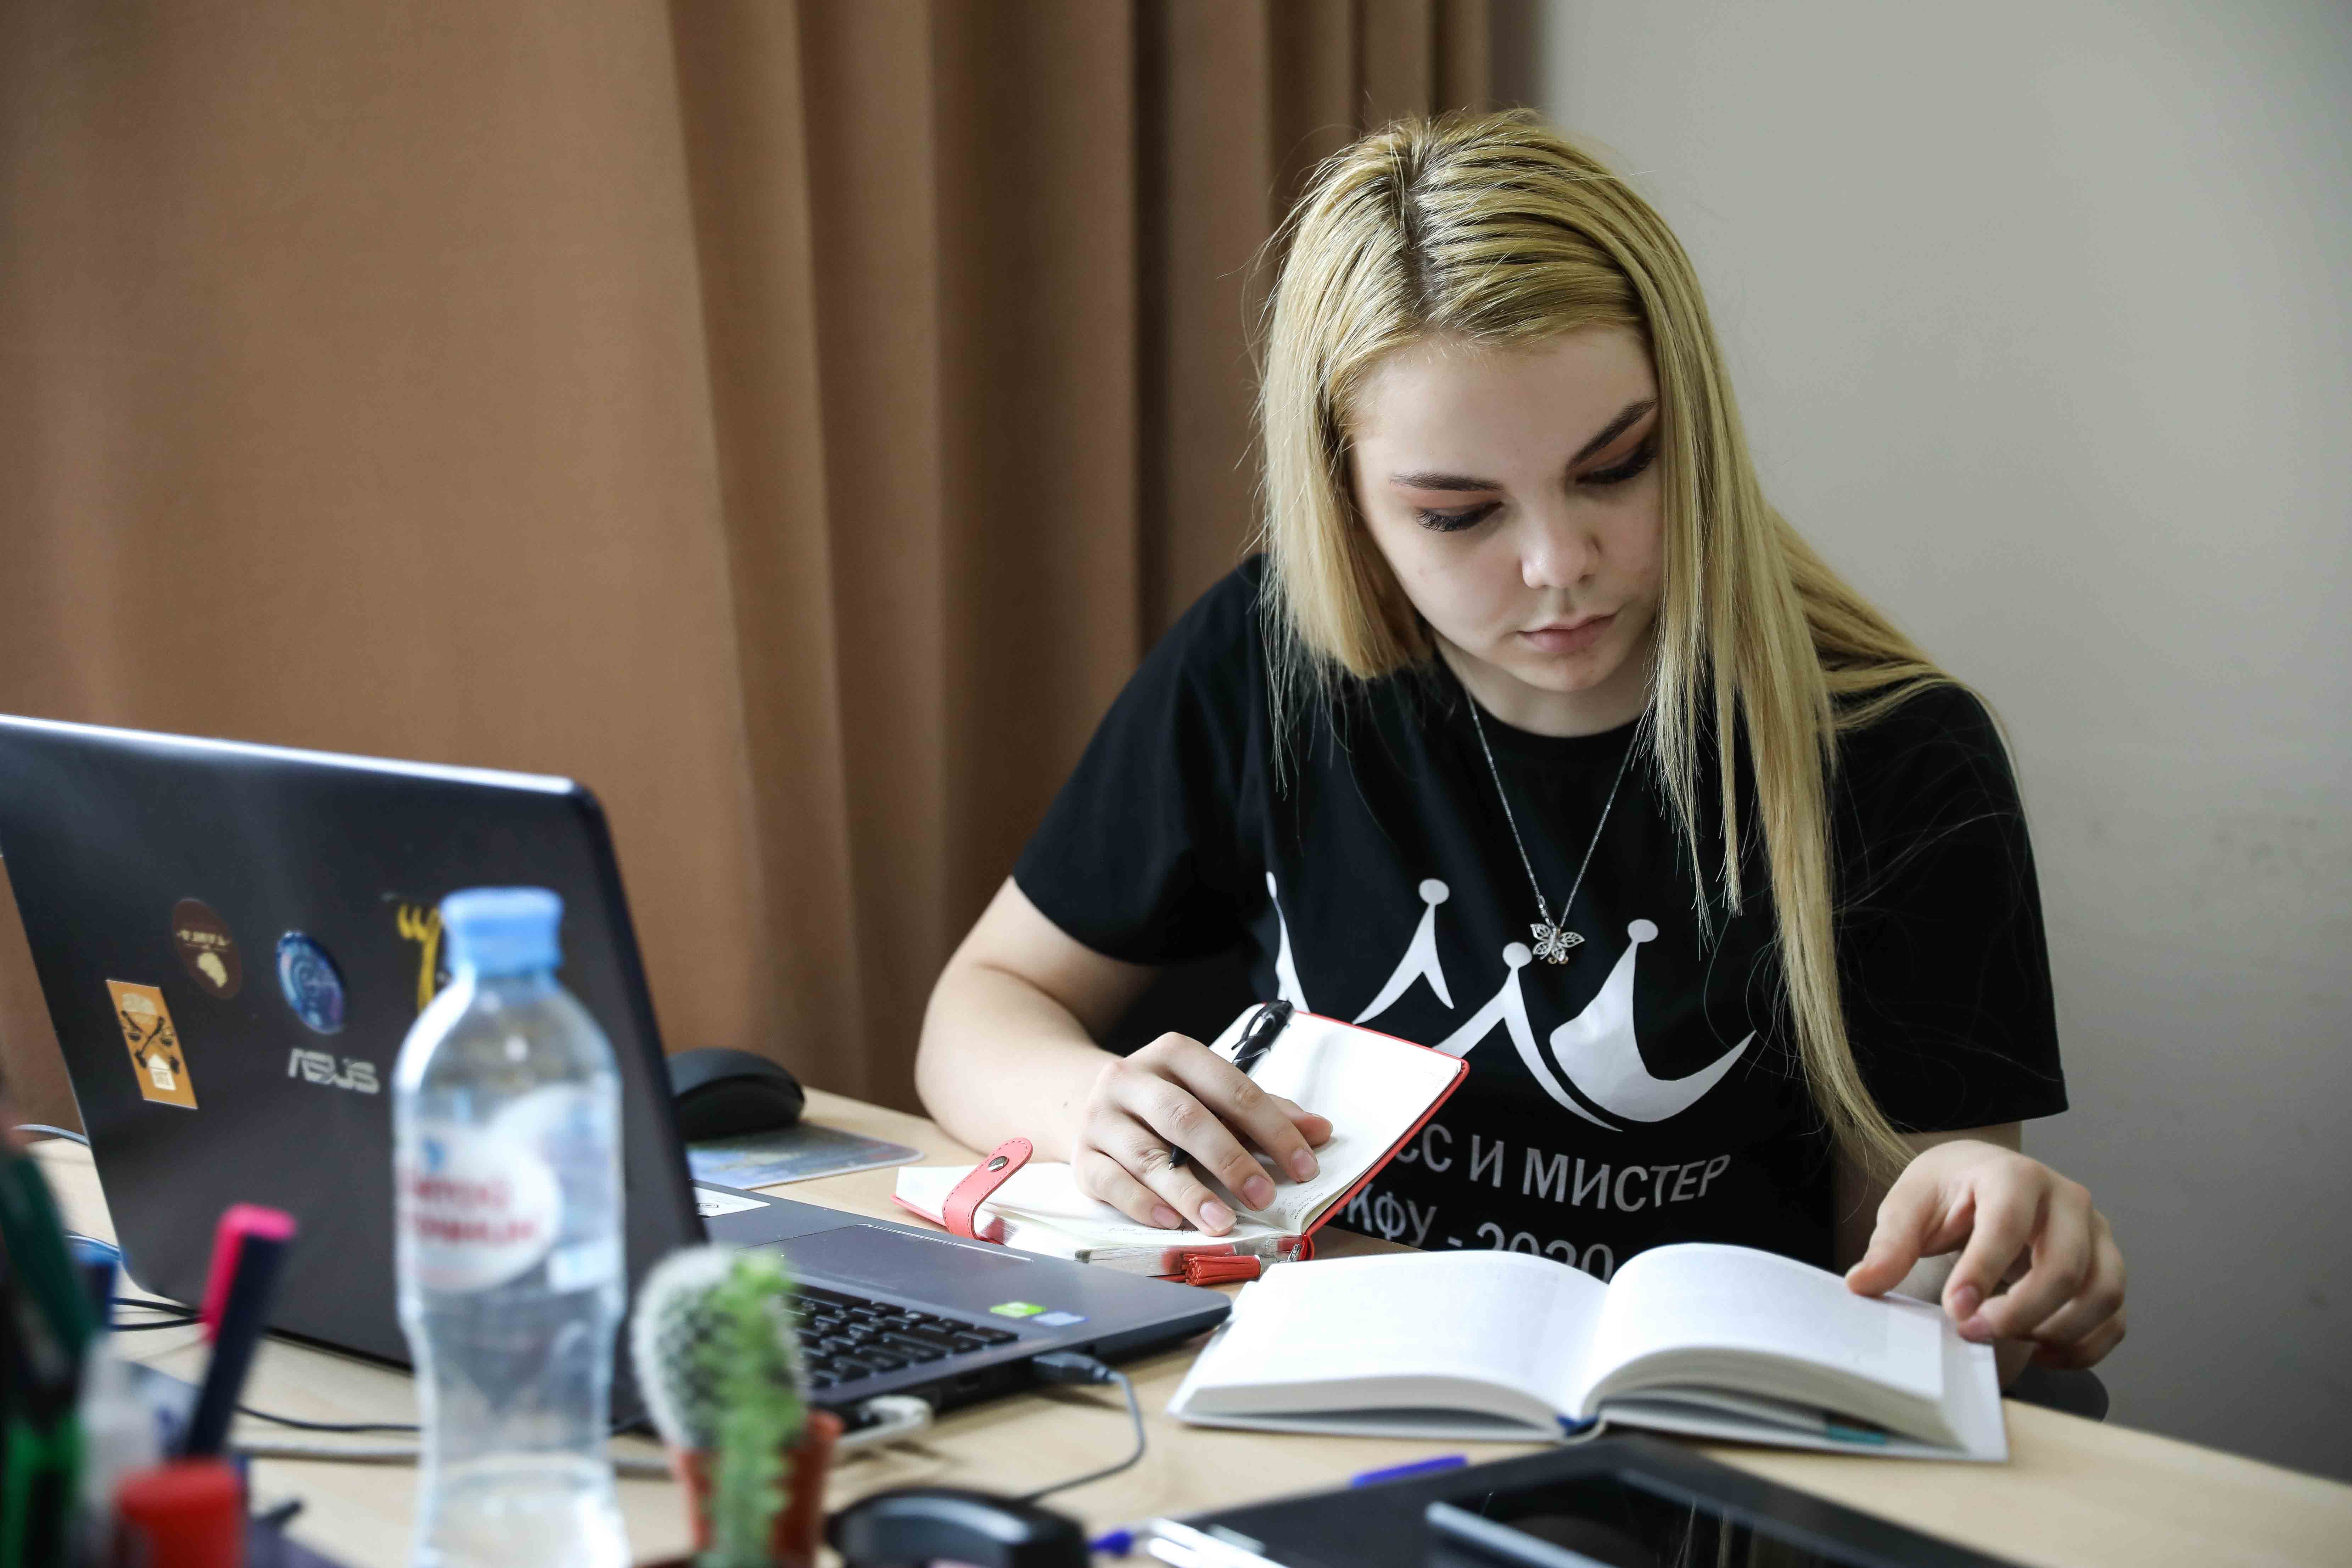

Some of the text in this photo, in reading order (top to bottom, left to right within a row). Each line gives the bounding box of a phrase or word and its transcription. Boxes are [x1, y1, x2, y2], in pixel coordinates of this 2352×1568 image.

[287, 1047, 380, 1095] ASUS
[1470, 1134, 1505, 1188] И
[1522, 1147, 1731, 1212] МИСТЕР
[1335, 1182, 1438, 1249] КФУ
